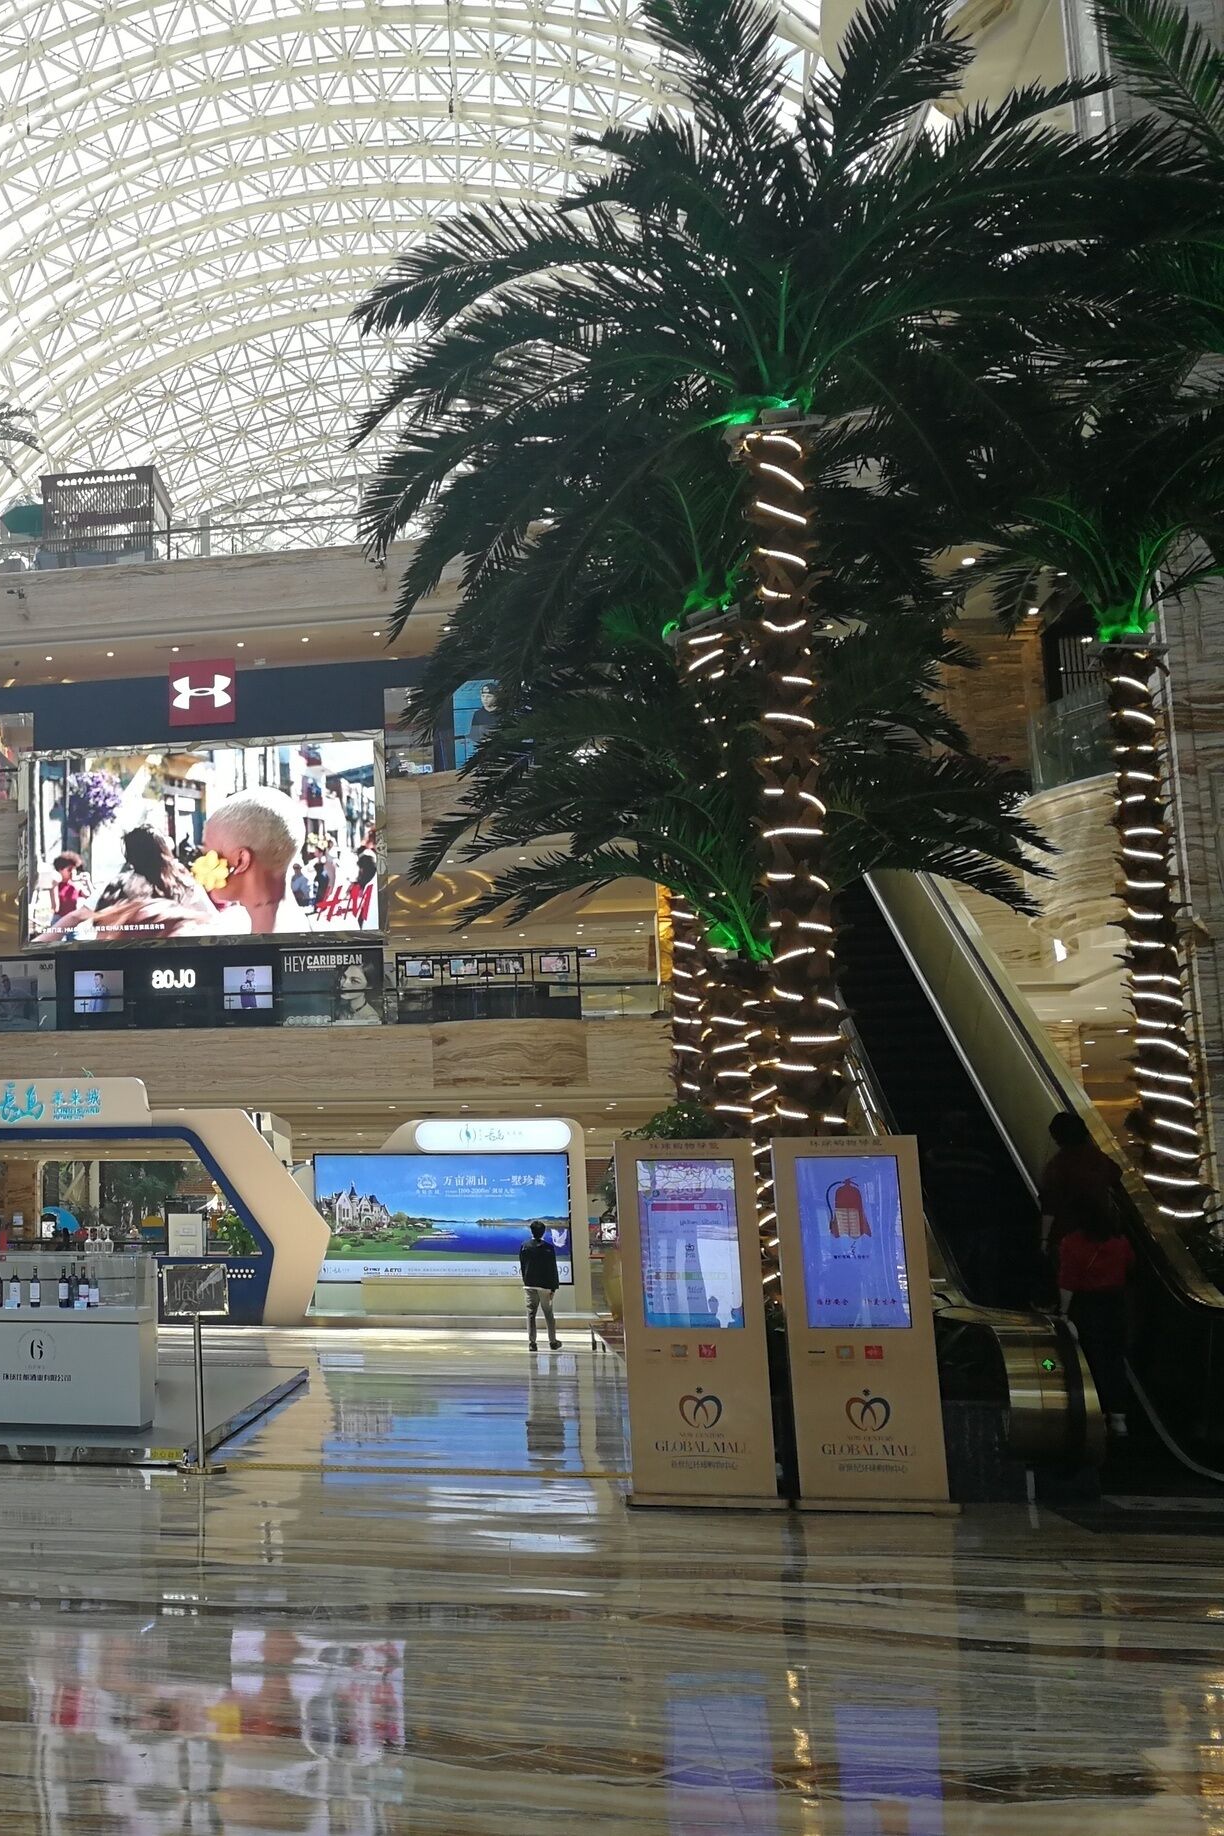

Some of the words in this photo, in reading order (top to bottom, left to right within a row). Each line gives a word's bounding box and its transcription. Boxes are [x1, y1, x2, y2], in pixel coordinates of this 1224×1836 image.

[316, 884, 374, 922] H&M
[284, 955, 306, 972] HEY
[306, 953, 363, 966] CARIBBEAN
[655, 1441, 710, 1453] GLOBAL
[821, 1443, 879, 1456] GLOBAL
